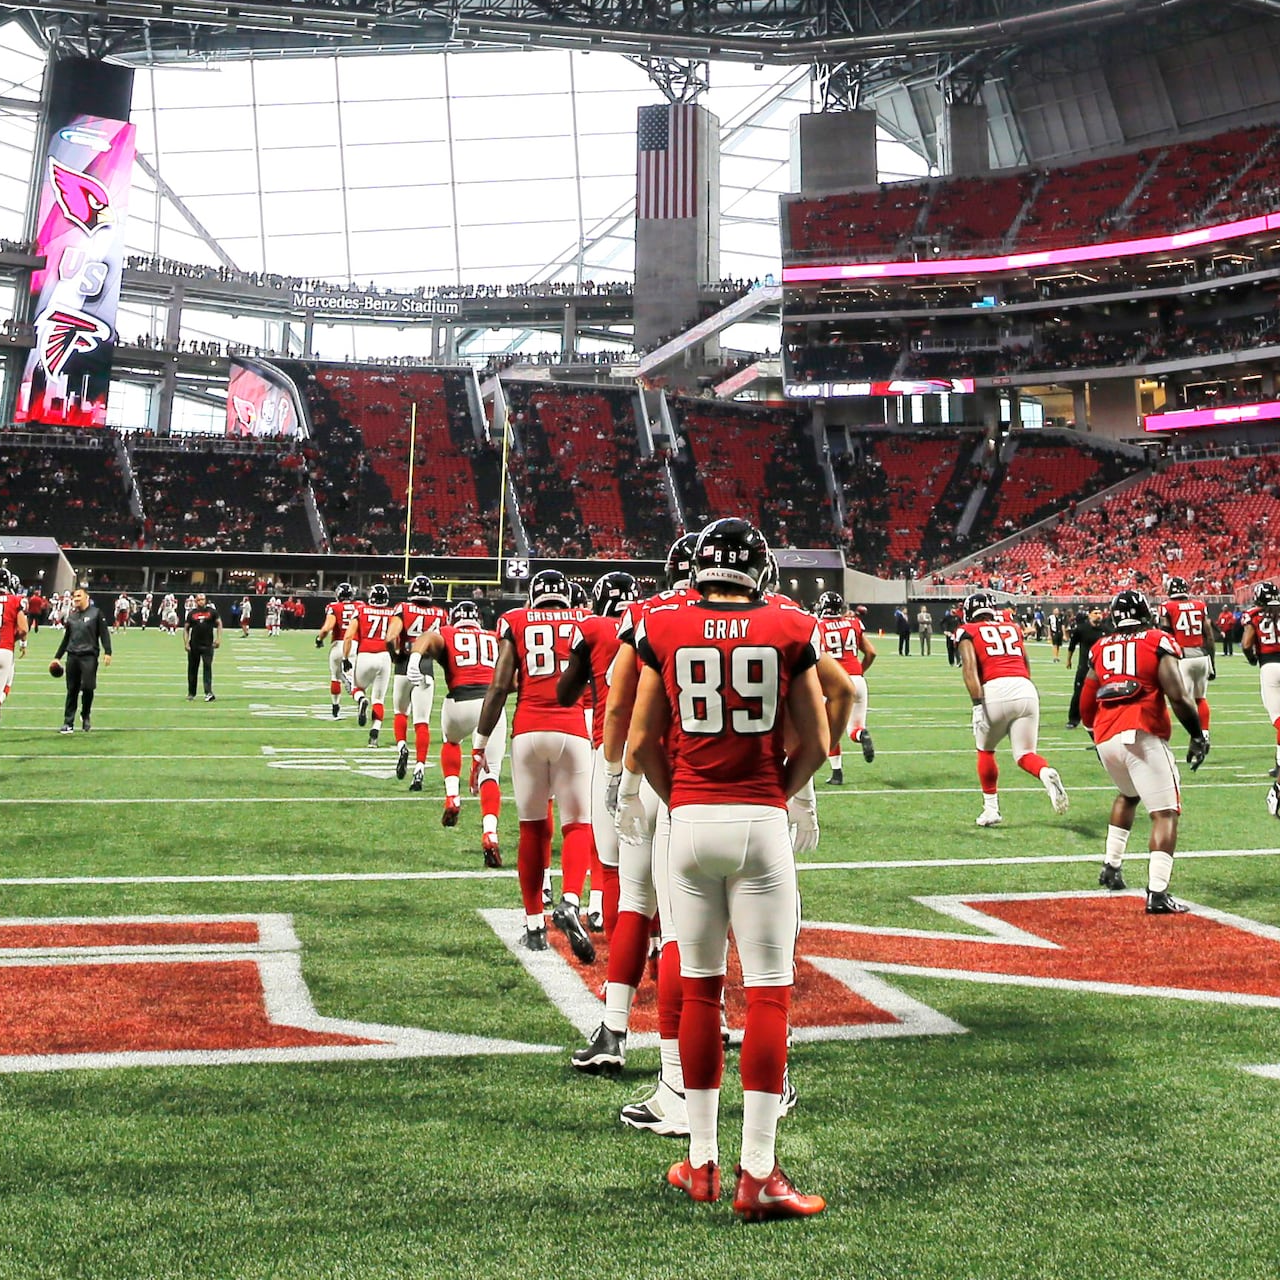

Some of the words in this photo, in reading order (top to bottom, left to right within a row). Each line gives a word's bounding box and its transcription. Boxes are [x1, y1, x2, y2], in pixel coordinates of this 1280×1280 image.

[293, 293, 398, 311] Mercedes-Benz
[401, 299, 459, 314] Stadium
[507, 560, 528, 577] 25
[714, 550, 737, 563] 89
[706, 571, 744, 581] FALCONS
[367, 615, 388, 640] 71
[527, 610, 583, 622] GRISWOLD
[1176, 610, 1203, 636] 45
[704, 619, 750, 640] GRAY
[979, 626, 1023, 656] 92
[454, 632, 499, 668] 90
[825, 629, 857, 659] 94
[1102, 641, 1137, 679] 91
[675, 646, 779, 734] 89
